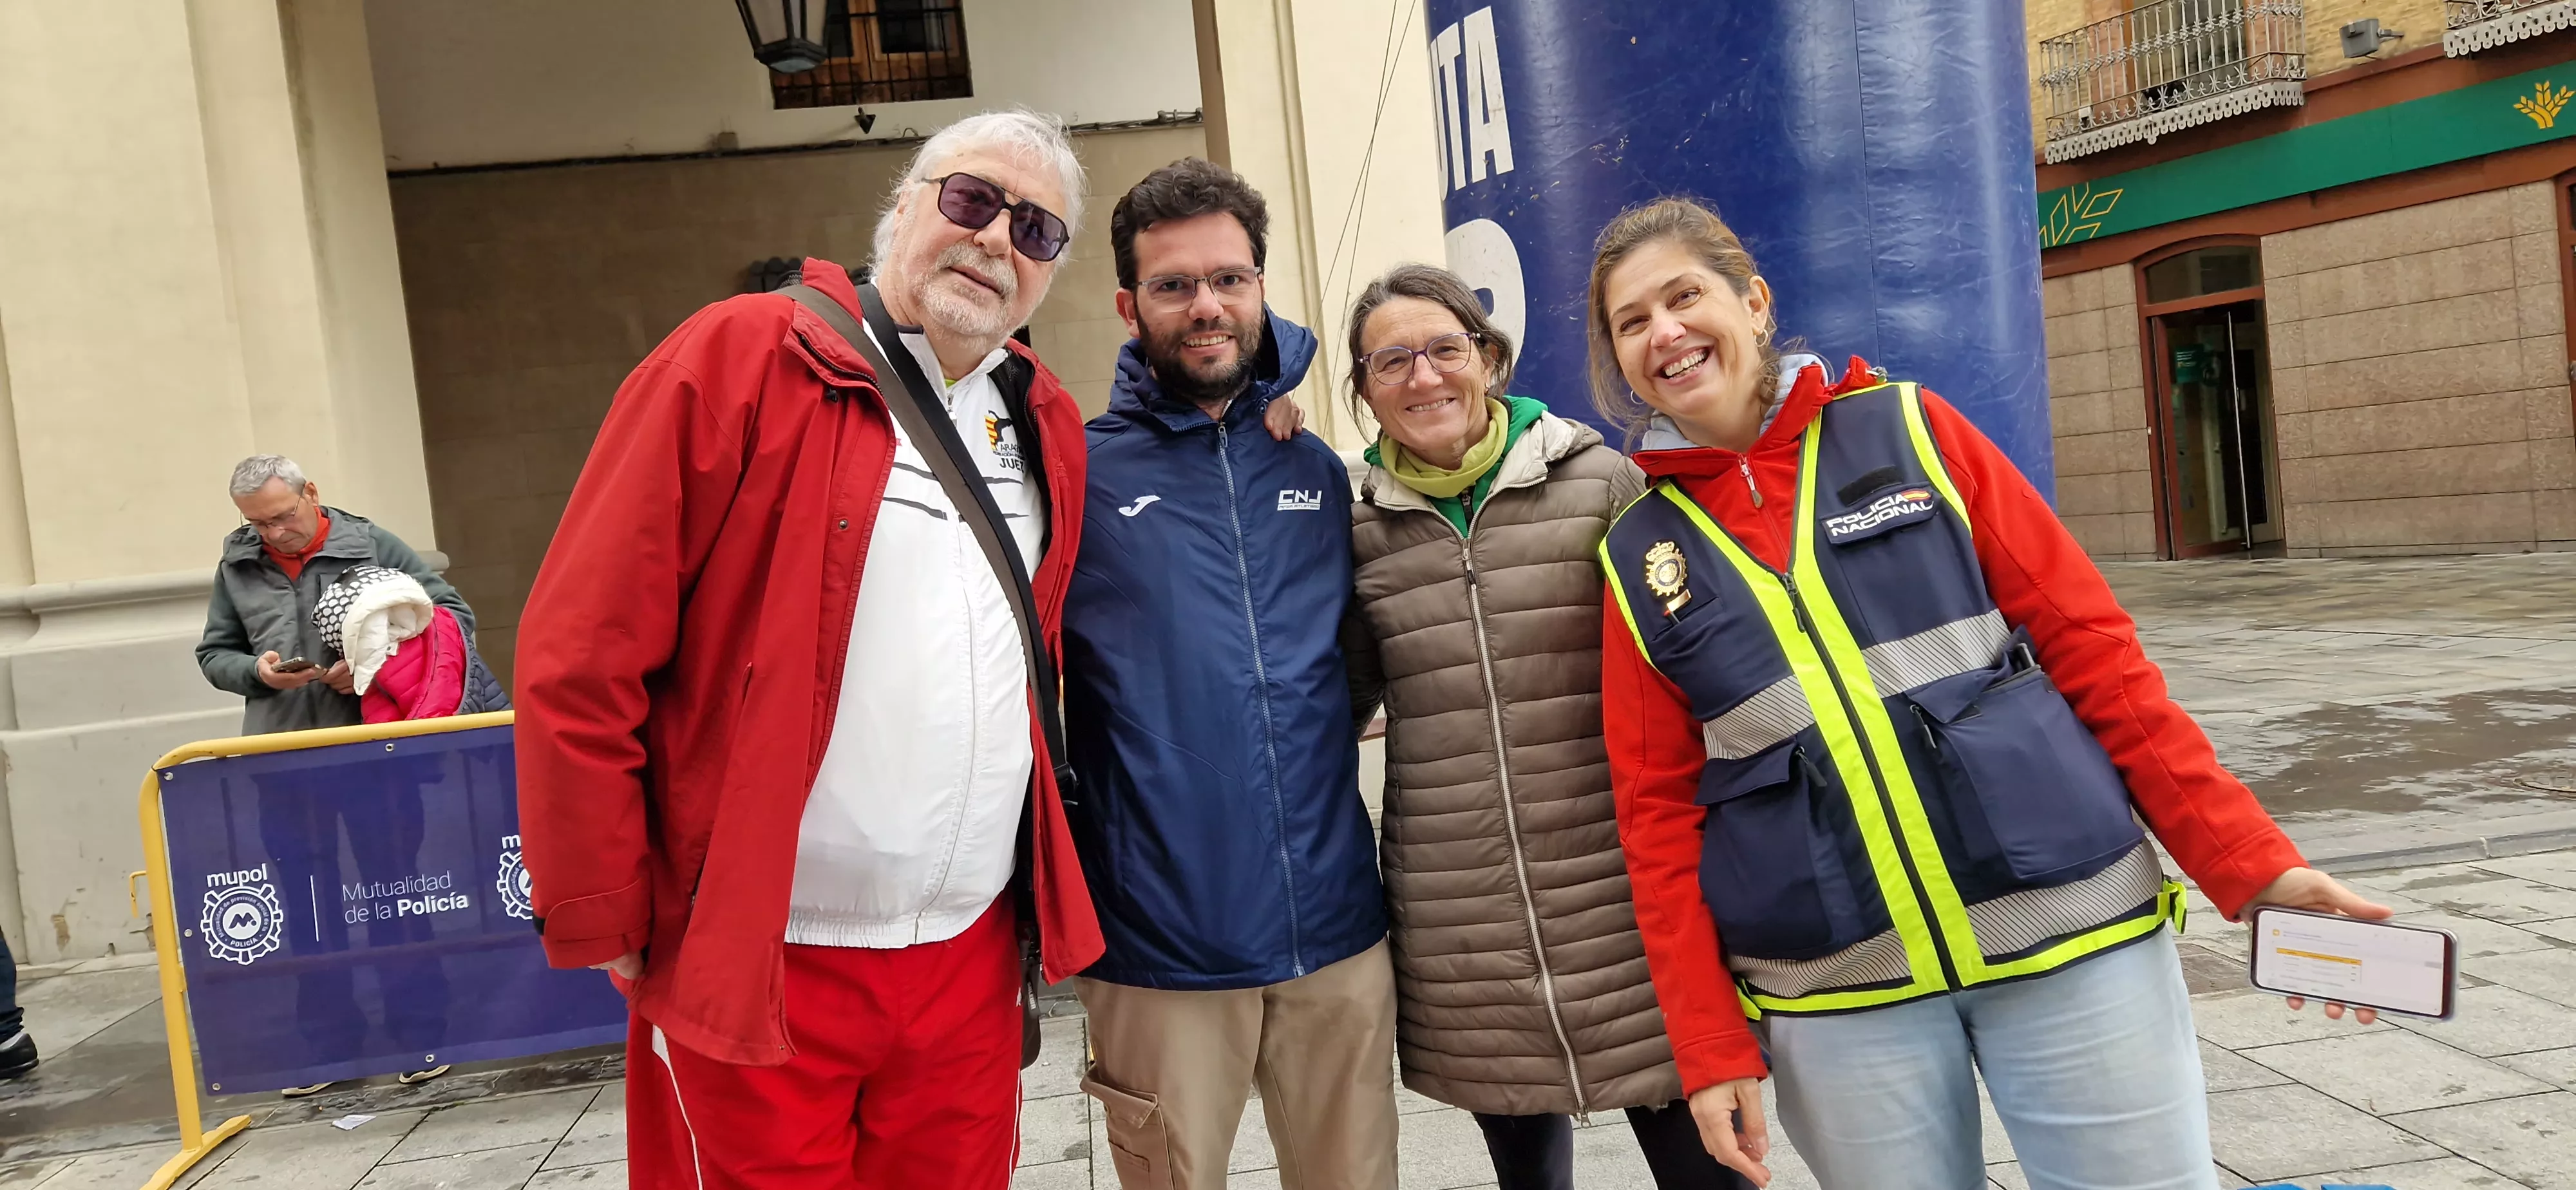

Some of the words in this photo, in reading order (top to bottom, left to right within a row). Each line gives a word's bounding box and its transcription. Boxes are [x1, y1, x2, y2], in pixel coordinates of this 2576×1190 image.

[1278, 489, 1322, 504] CNJ
[1831, 500, 1935, 536] NACIONAL
[207, 863, 268, 888] mupol
[342, 870, 451, 902] Mutualidad
[345, 905, 369, 924] de
[375, 902, 392, 920] la
[397, 891, 469, 918] Policía
